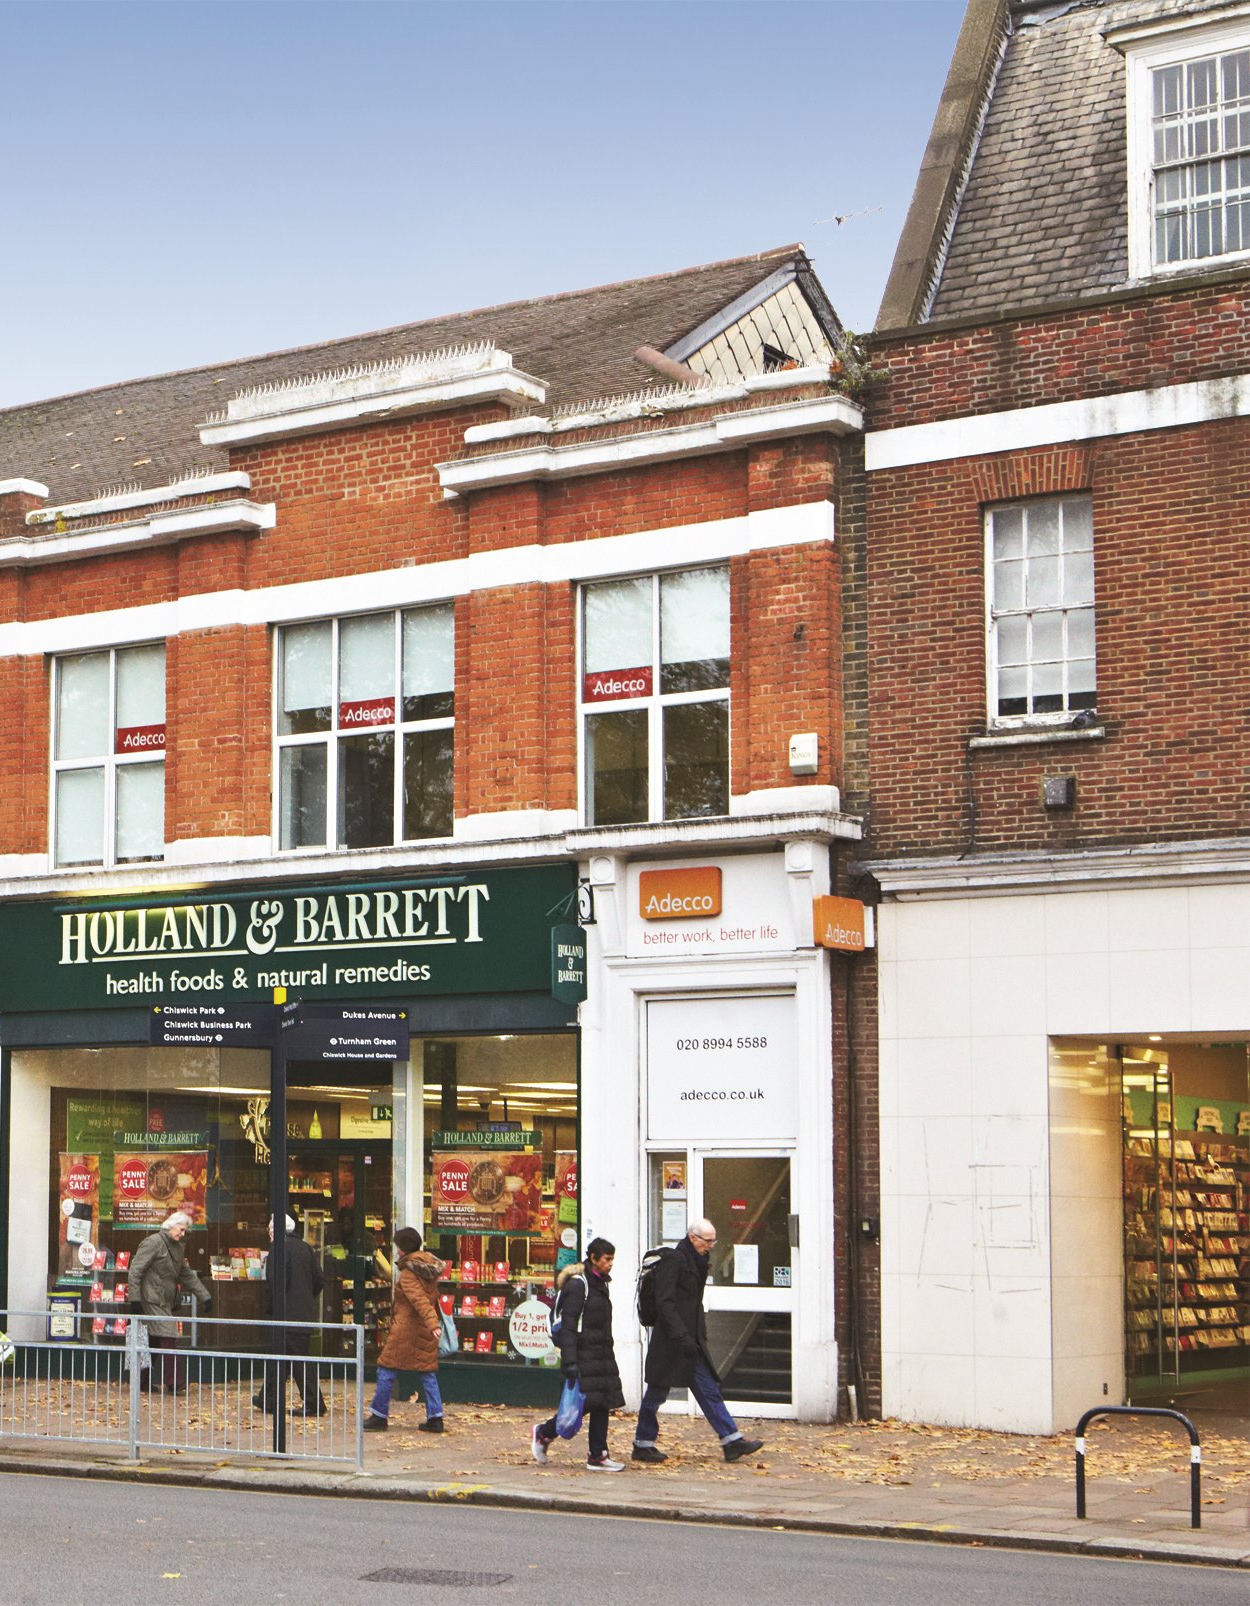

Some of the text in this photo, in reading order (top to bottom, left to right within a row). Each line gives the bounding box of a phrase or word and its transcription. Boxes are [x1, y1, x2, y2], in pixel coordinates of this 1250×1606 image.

[592, 679, 645, 695] Adecco
[345, 707, 391, 722] Adecco
[123, 732, 166, 747] Adecco
[645, 893, 713, 913] Adecco
[59, 884, 490, 964] HOLLAND & BARRETT
[643, 925, 779, 945] better work, better life
[825, 923, 862, 946] Adecco
[557, 944, 584, 958] HOLLAND
[106, 959, 431, 995] health foods & natural remedies
[557, 970, 584, 984] BARRETT
[163, 1006, 216, 1015] Chiswick Park
[342, 1011, 396, 1019] Dukes Avenue
[164, 1021, 252, 1029] Chiswick Business Park
[163, 1033, 213, 1043] Gunnersbury
[338, 1037, 396, 1046] Turnham Green
[676, 1036, 767, 1050] 020 8994 5588
[680, 1088, 765, 1101] adecco.co.uk
[70, 1103, 105, 1115] Rewarding
[88, 1119, 102, 1128] way
[103, 1117, 111, 1127] of
[123, 1132, 159, 1144] HOLLAND
[159, 1132, 167, 1144] &
[168, 1133, 200, 1144] BARRETT
[444, 1132, 532, 1144] HOLLAND & BARRETT
[122, 1171, 146, 1179] PENNY
[441, 1172, 468, 1180] PENNY
[69, 1181, 89, 1190] SALE
[122, 1179, 145, 1189] SALE
[441, 1181, 468, 1191] SALE
[515, 1312, 526, 1320] Buy
[512, 1322, 528, 1332] 1/2
